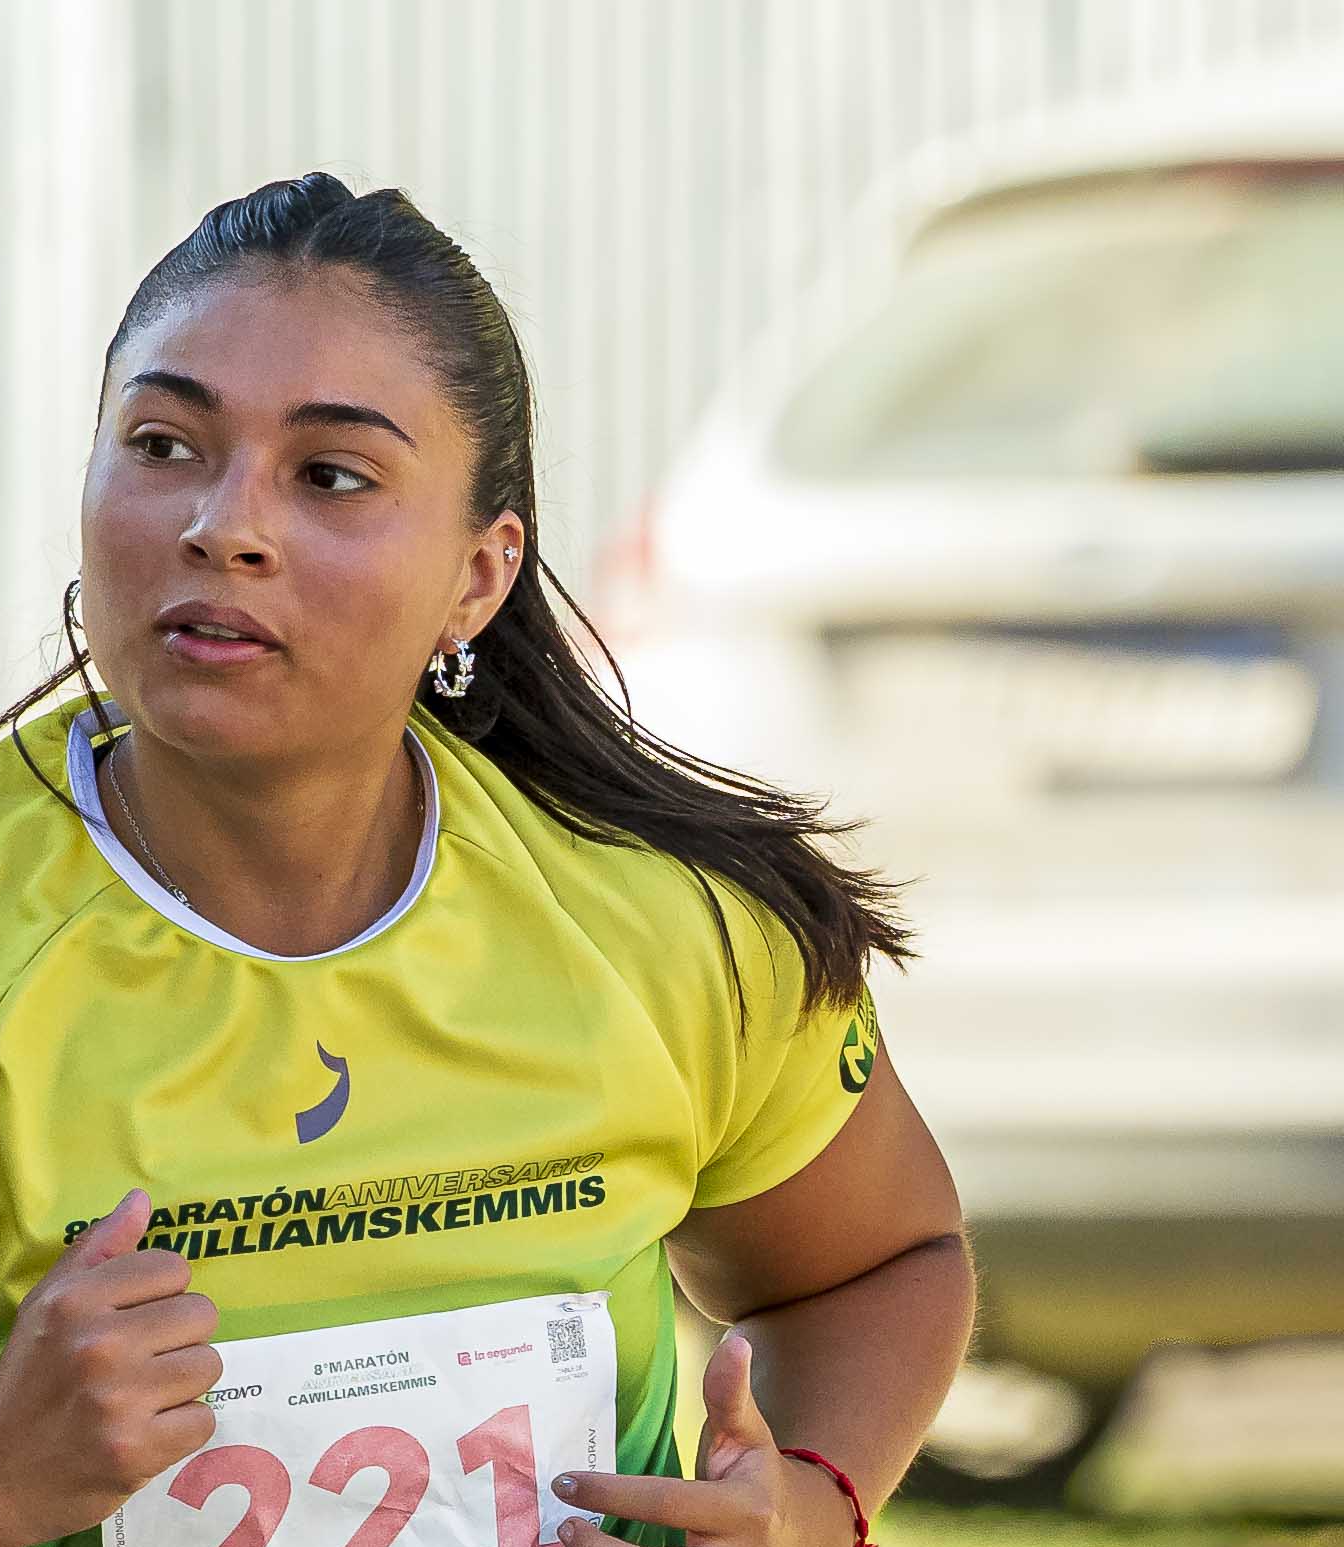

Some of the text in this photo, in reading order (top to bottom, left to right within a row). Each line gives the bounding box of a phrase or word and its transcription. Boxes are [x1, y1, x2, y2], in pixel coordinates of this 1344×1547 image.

[136, 1174, 606, 1261] WILLIAMSKEMMIS
[145, 1186, 327, 1233] ARATÓN
[323, 1152, 605, 1211] ANIVERSARIO
[486, 1341, 534, 1360] segunda
[287, 1374, 438, 1406] CAWILLIAMSKEMMIS
